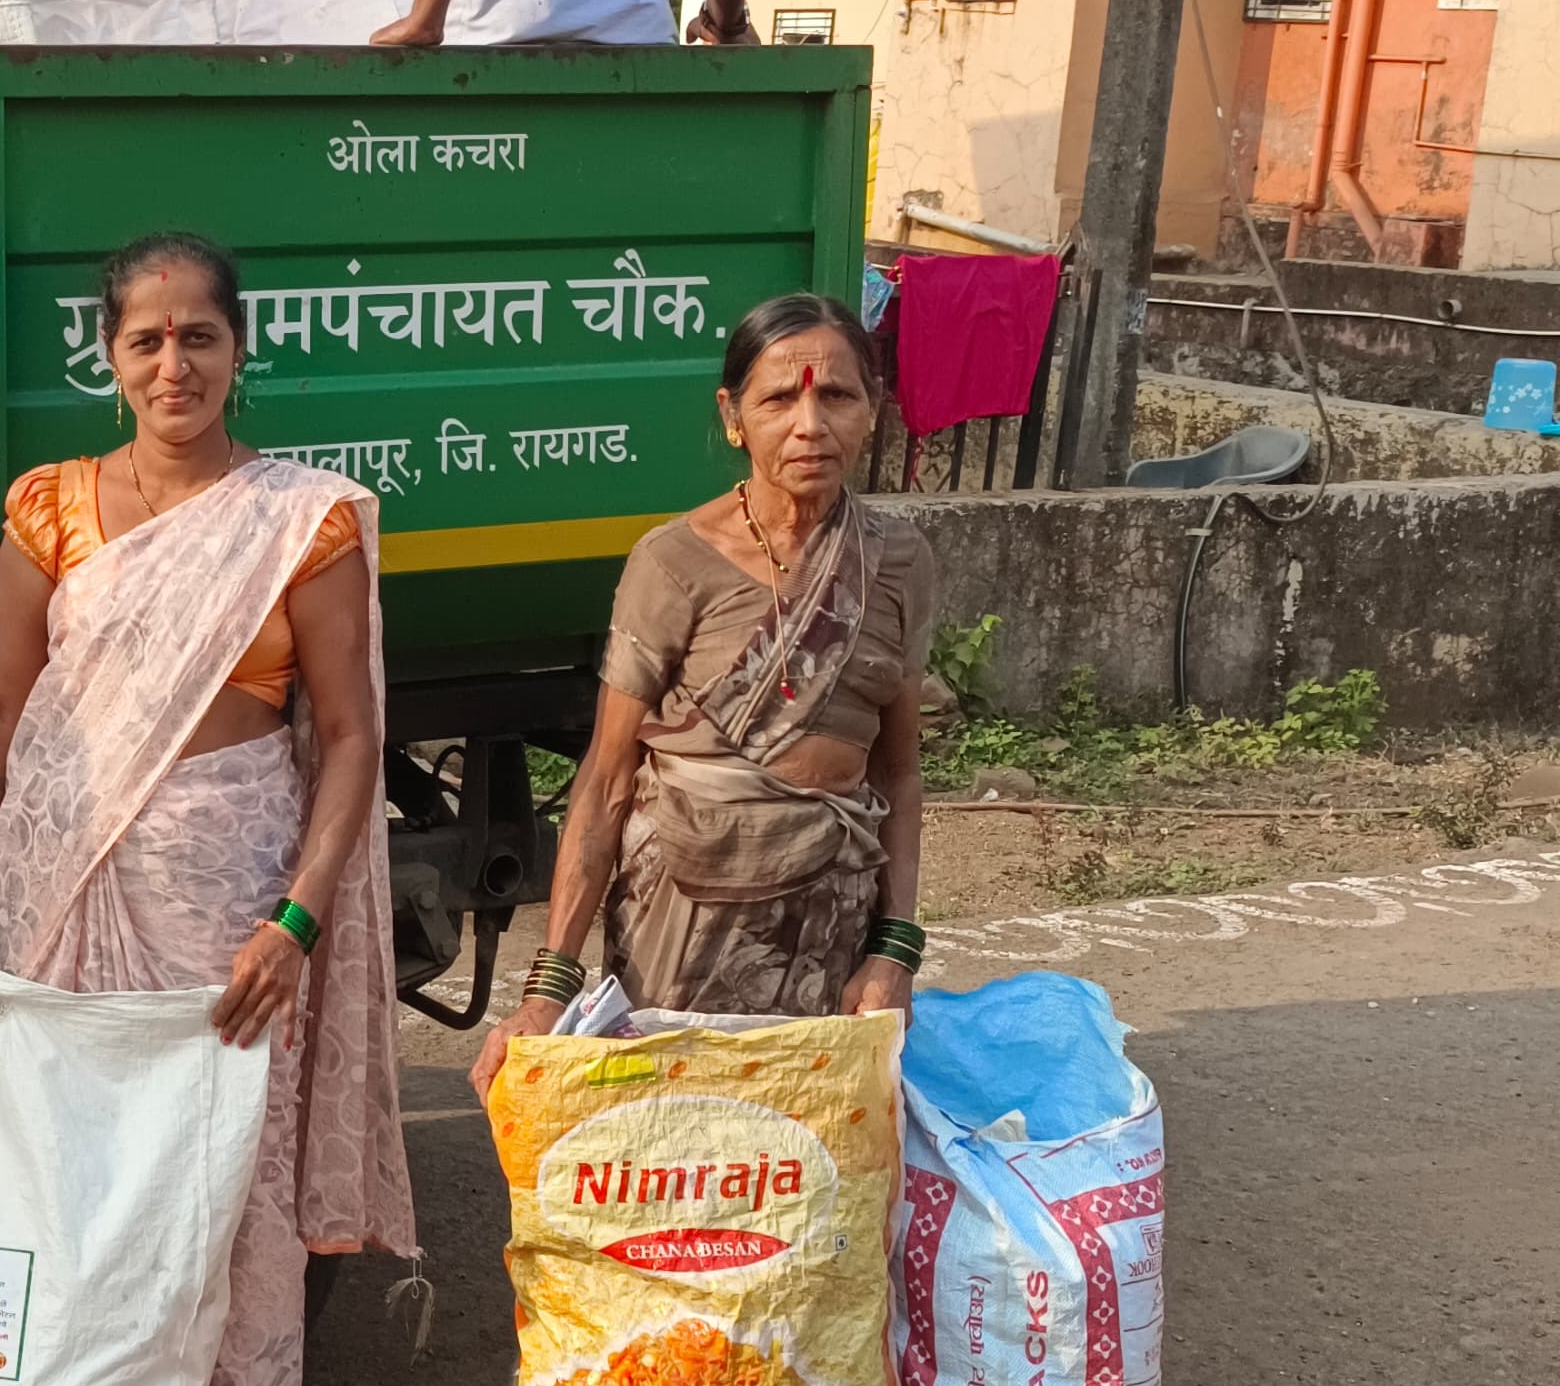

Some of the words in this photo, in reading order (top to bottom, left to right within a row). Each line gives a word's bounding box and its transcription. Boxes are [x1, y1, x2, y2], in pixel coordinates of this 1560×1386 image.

[326, 119, 421, 174] ओला
[428, 133, 529, 172] कचरा
[565, 248, 726, 342] चौक.
[434, 417, 496, 475] जि.
[508, 424, 637, 471] रायगड.
[573, 1152, 803, 1213] Nimraja
[626, 1241, 693, 1261] CHANA
[698, 1239, 761, 1258] BESAN
